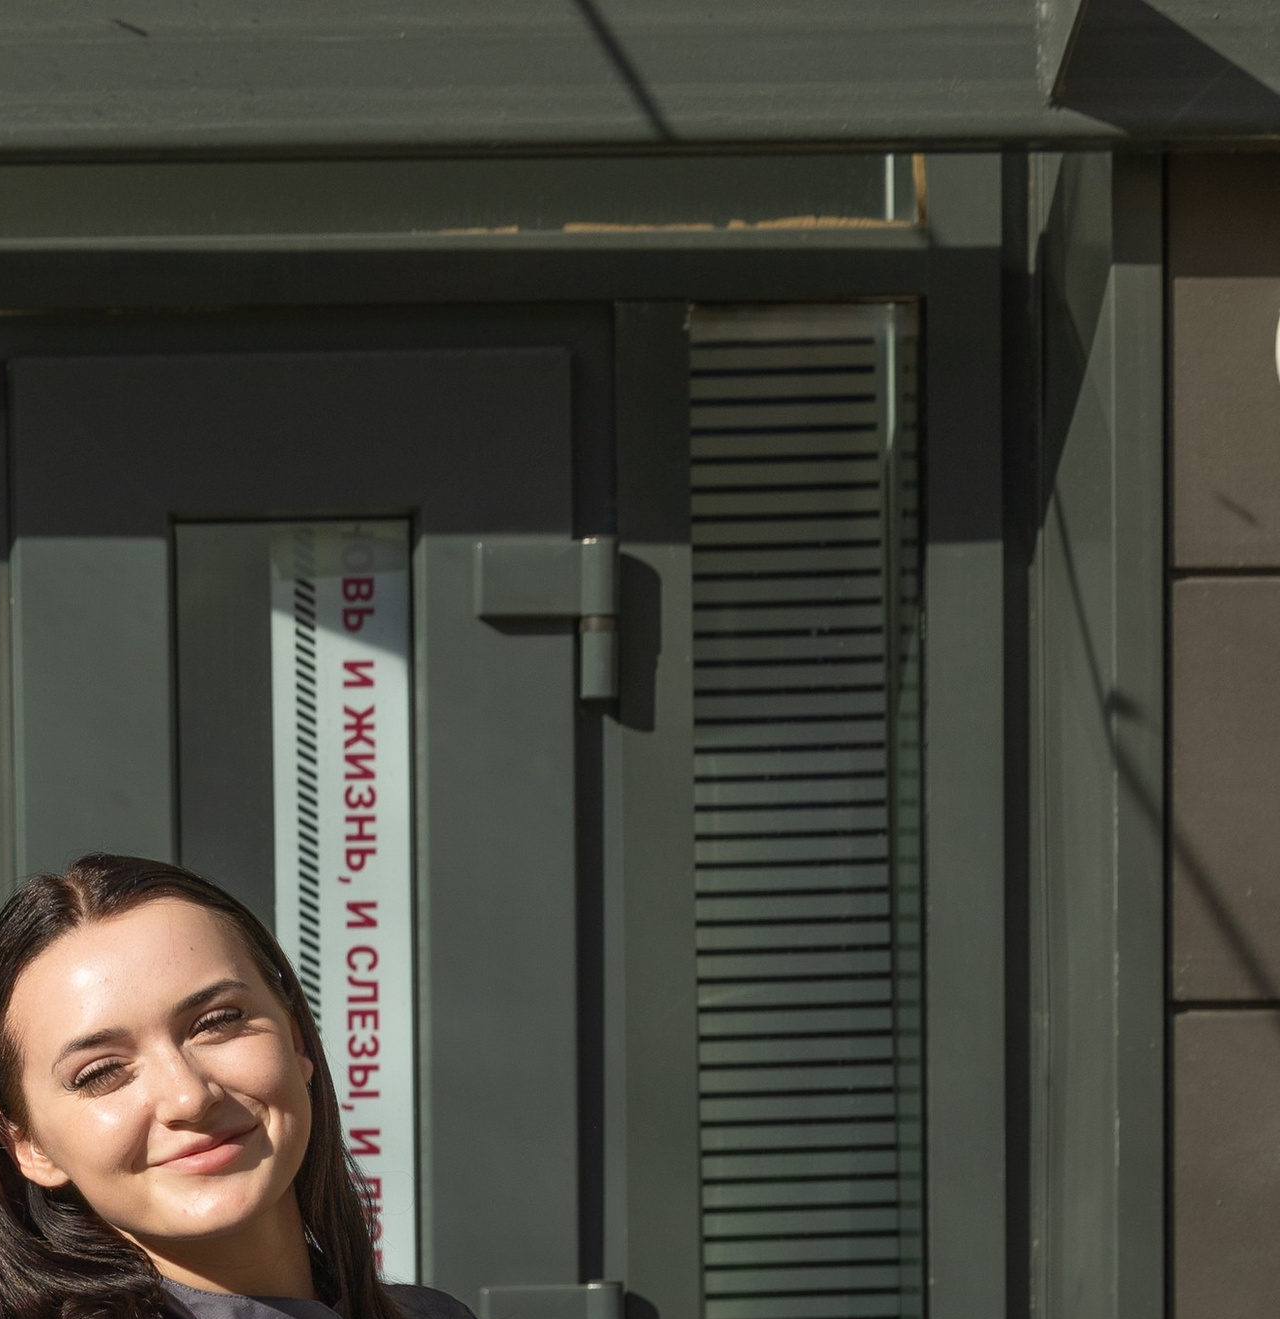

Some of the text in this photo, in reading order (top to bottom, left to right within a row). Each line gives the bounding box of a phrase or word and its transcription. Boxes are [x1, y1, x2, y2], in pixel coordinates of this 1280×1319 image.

[342, 660, 375, 689] И
[337, 703, 377, 885] ЖИЗНЬ,
[346, 901, 378, 930] И
[341, 945, 381, 1112] СЛЕЗЫ,
[349, 1128, 381, 1156] И
